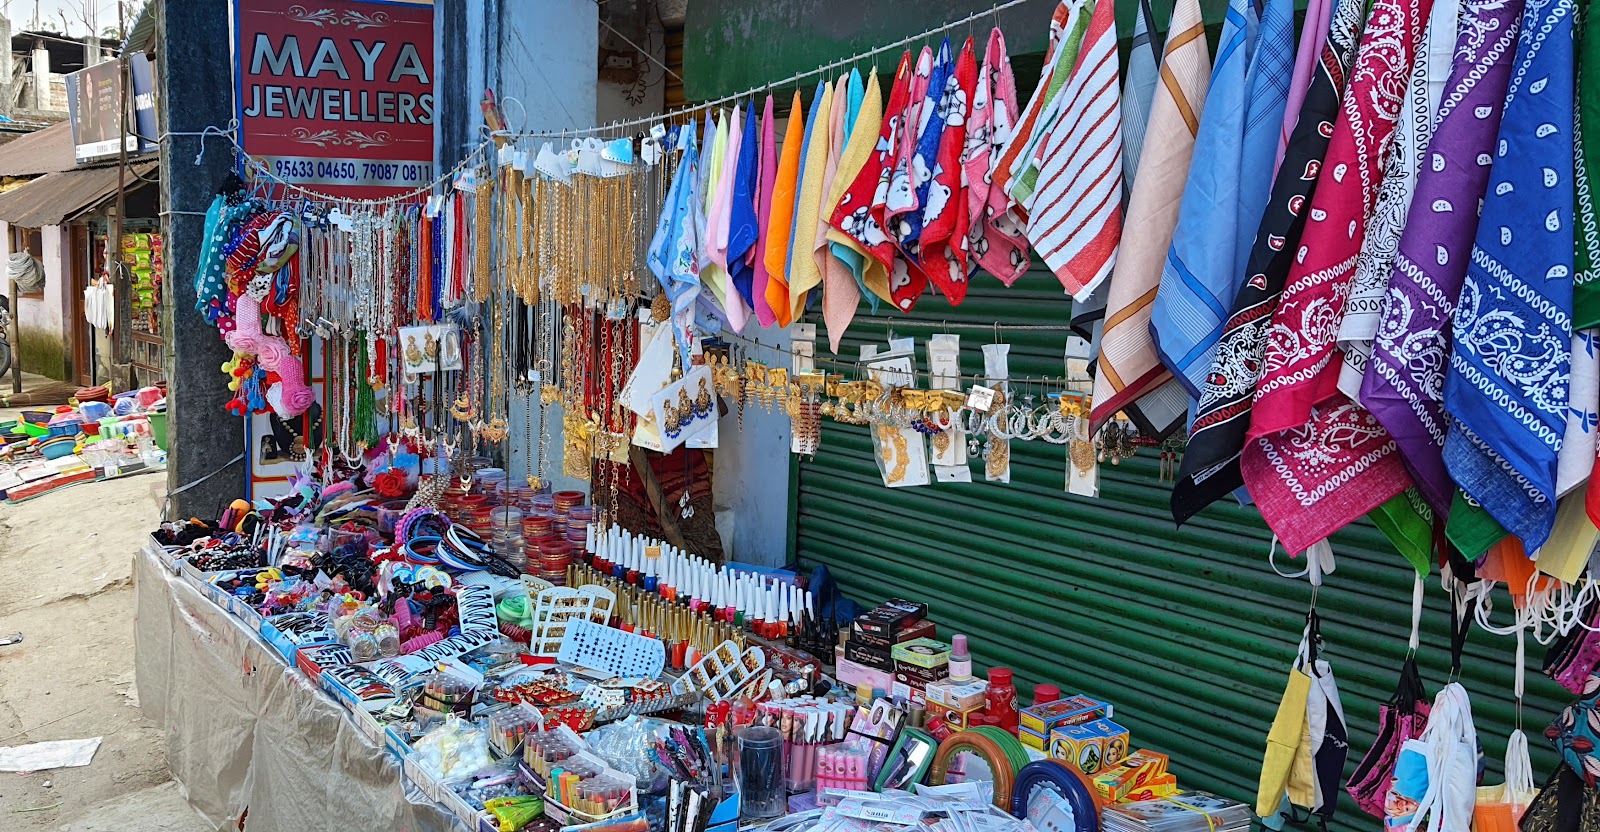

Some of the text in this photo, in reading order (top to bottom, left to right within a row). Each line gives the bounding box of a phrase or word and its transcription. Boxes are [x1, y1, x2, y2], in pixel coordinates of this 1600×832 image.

[249, 32, 430, 84] MAYA
[244, 84, 434, 124] JEWELLERS
[276, 160, 433, 182] 95633 04650, 79087 0811
